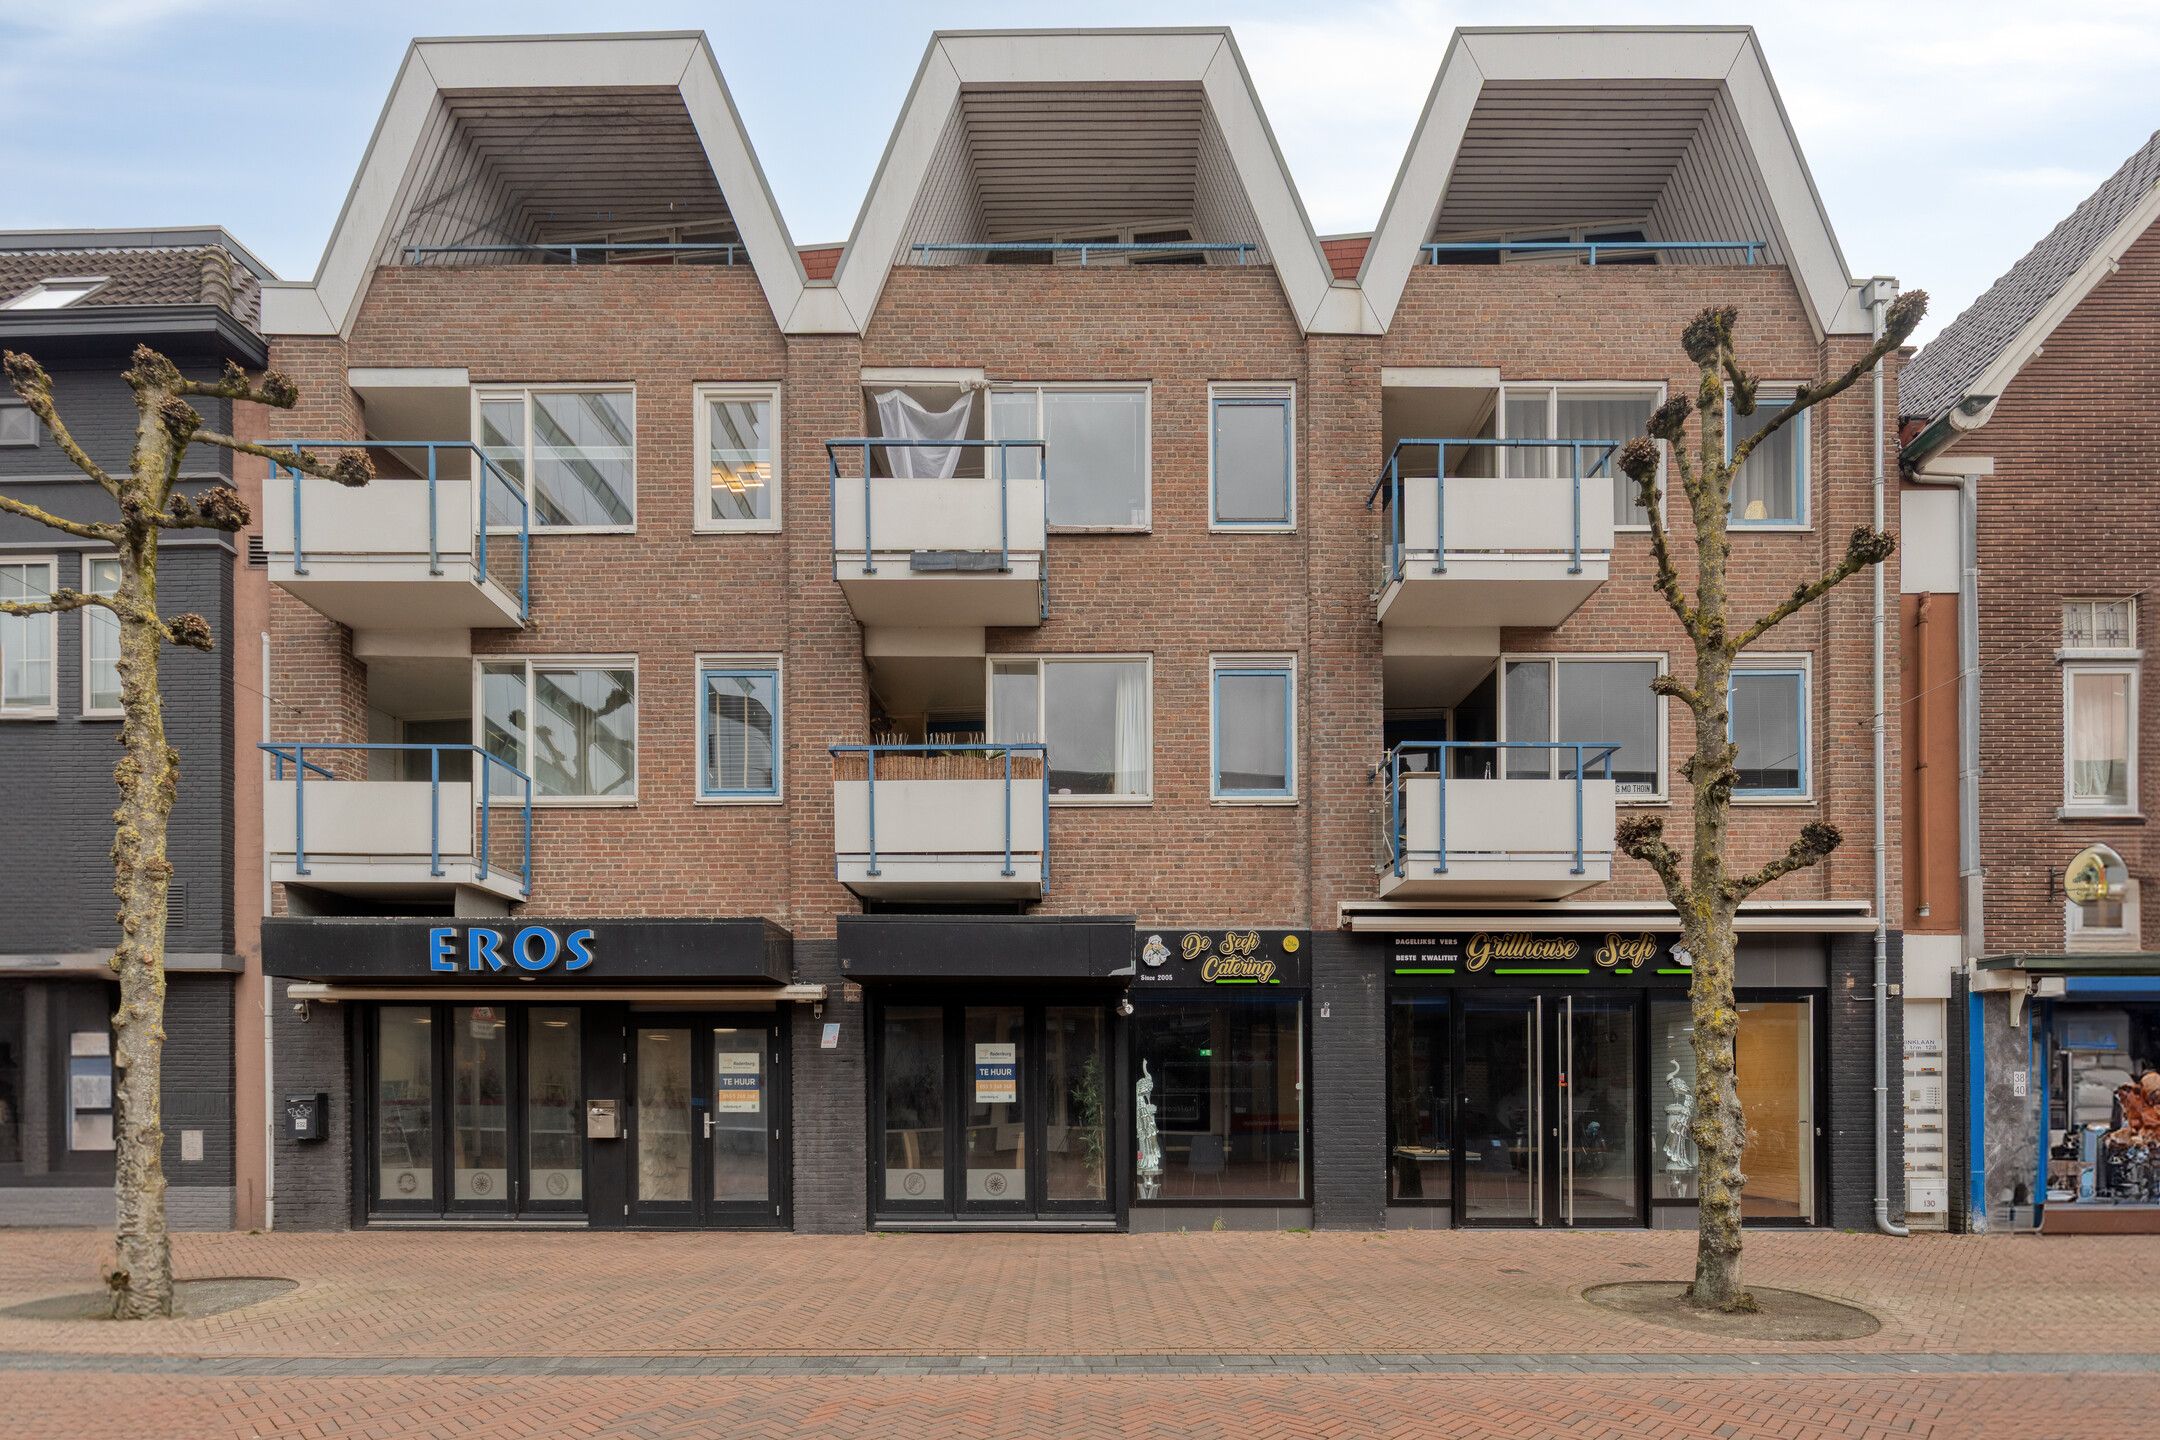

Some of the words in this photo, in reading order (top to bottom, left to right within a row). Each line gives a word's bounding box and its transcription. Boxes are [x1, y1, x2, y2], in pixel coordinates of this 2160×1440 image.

[430, 925, 595, 972] EROS
[1181, 932, 1212, 960] De
[1219, 931, 1260, 956] Seefi
[1466, 932, 1580, 972] Grillhouse
[1595, 931, 1657, 968] Seefi
[1202, 954, 1276, 983] Catering
[979, 1068, 989, 1076] TE
[990, 1068, 1012, 1076] HUUR
[2014, 1073, 2025, 1083] 38
[723, 1078, 733, 1086] TE
[734, 1078, 756, 1086] HUUR
[2014, 1085, 2025, 1095] 40
